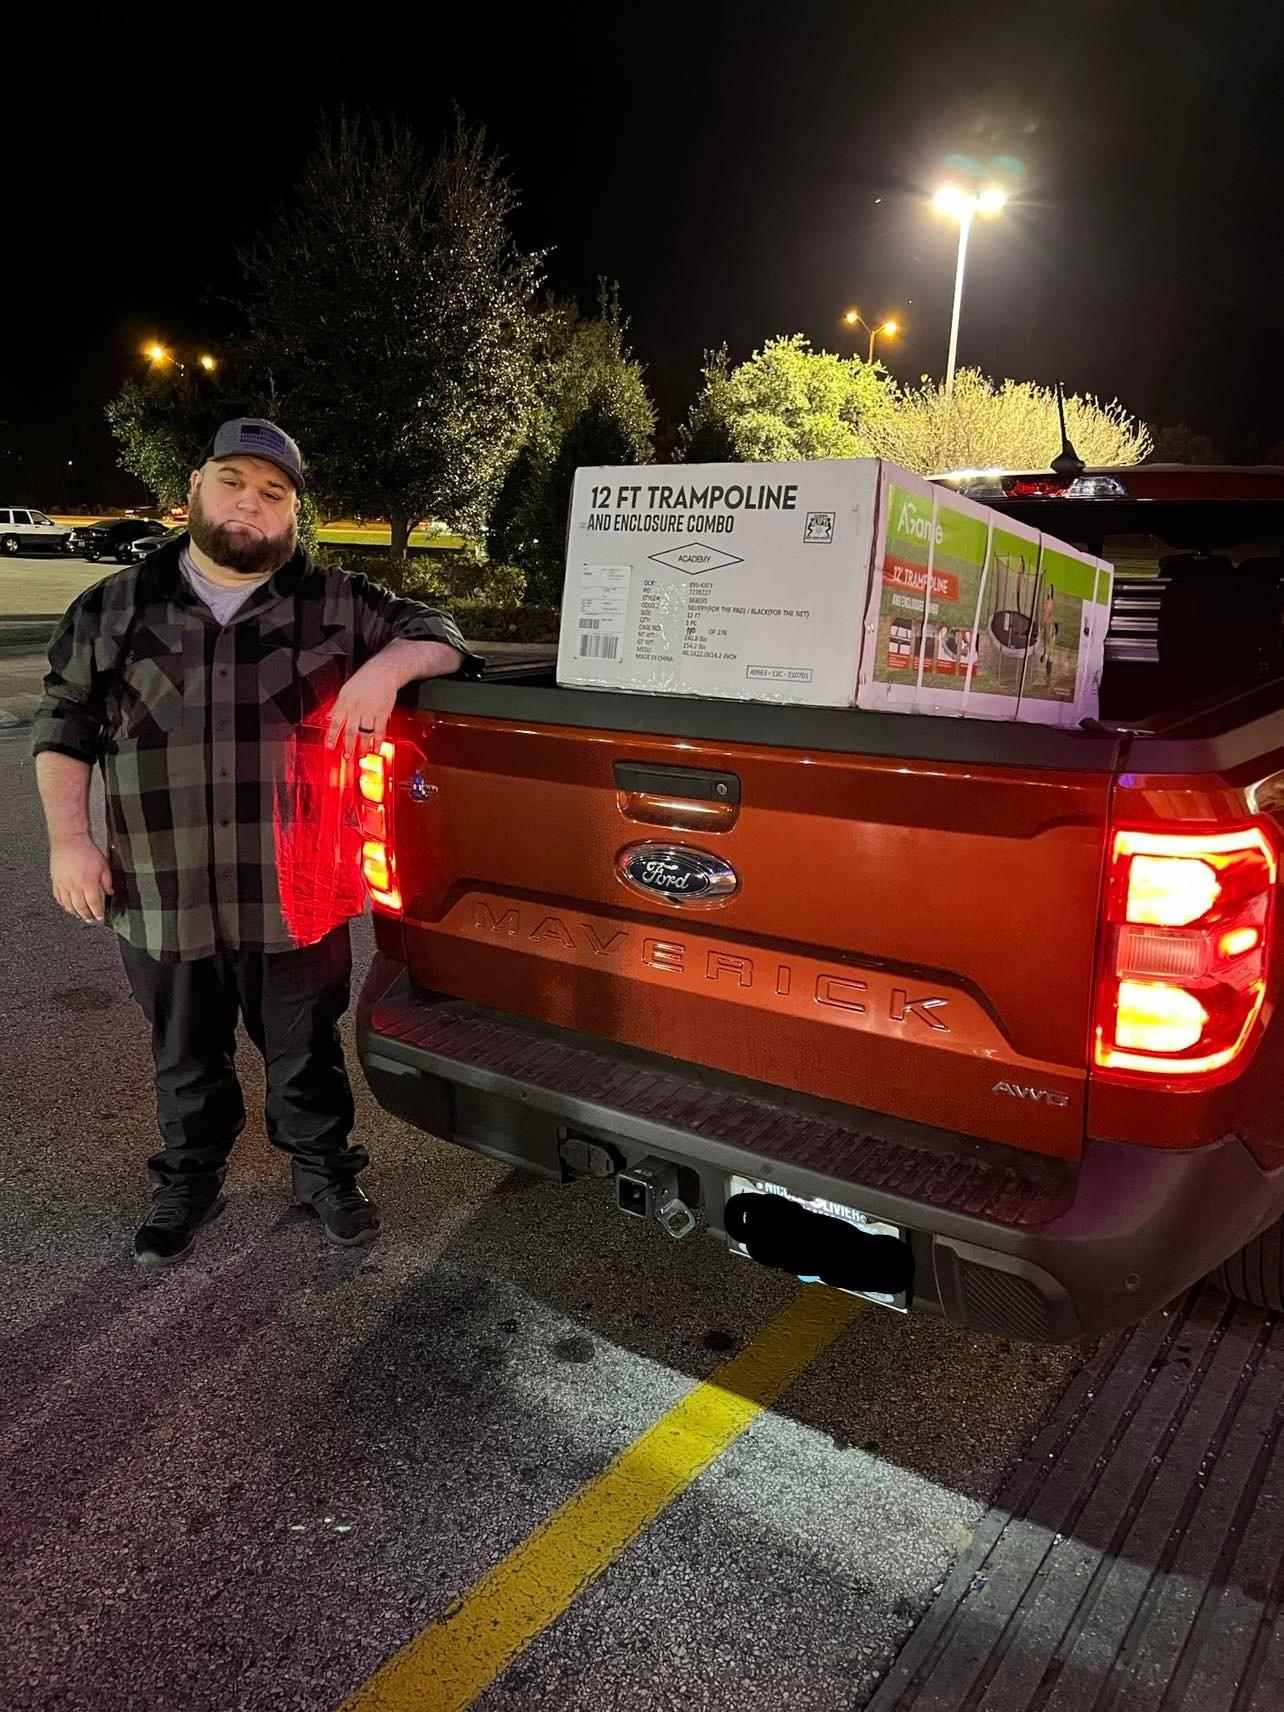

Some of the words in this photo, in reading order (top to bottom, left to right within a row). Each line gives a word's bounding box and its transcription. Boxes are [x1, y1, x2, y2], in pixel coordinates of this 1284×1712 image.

[591, 486, 611, 508] 12
[616, 486, 641, 508] FT
[648, 485, 798, 510] TRAMPOLINE
[587, 514, 611, 531] AND
[613, 514, 684, 532] ENCLOSURE
[687, 515, 734, 533] COMBO
[678, 555, 711, 563] ACADEMY
[641, 861, 692, 890] Ford
[473, 900, 951, 1033] MAVERICK
